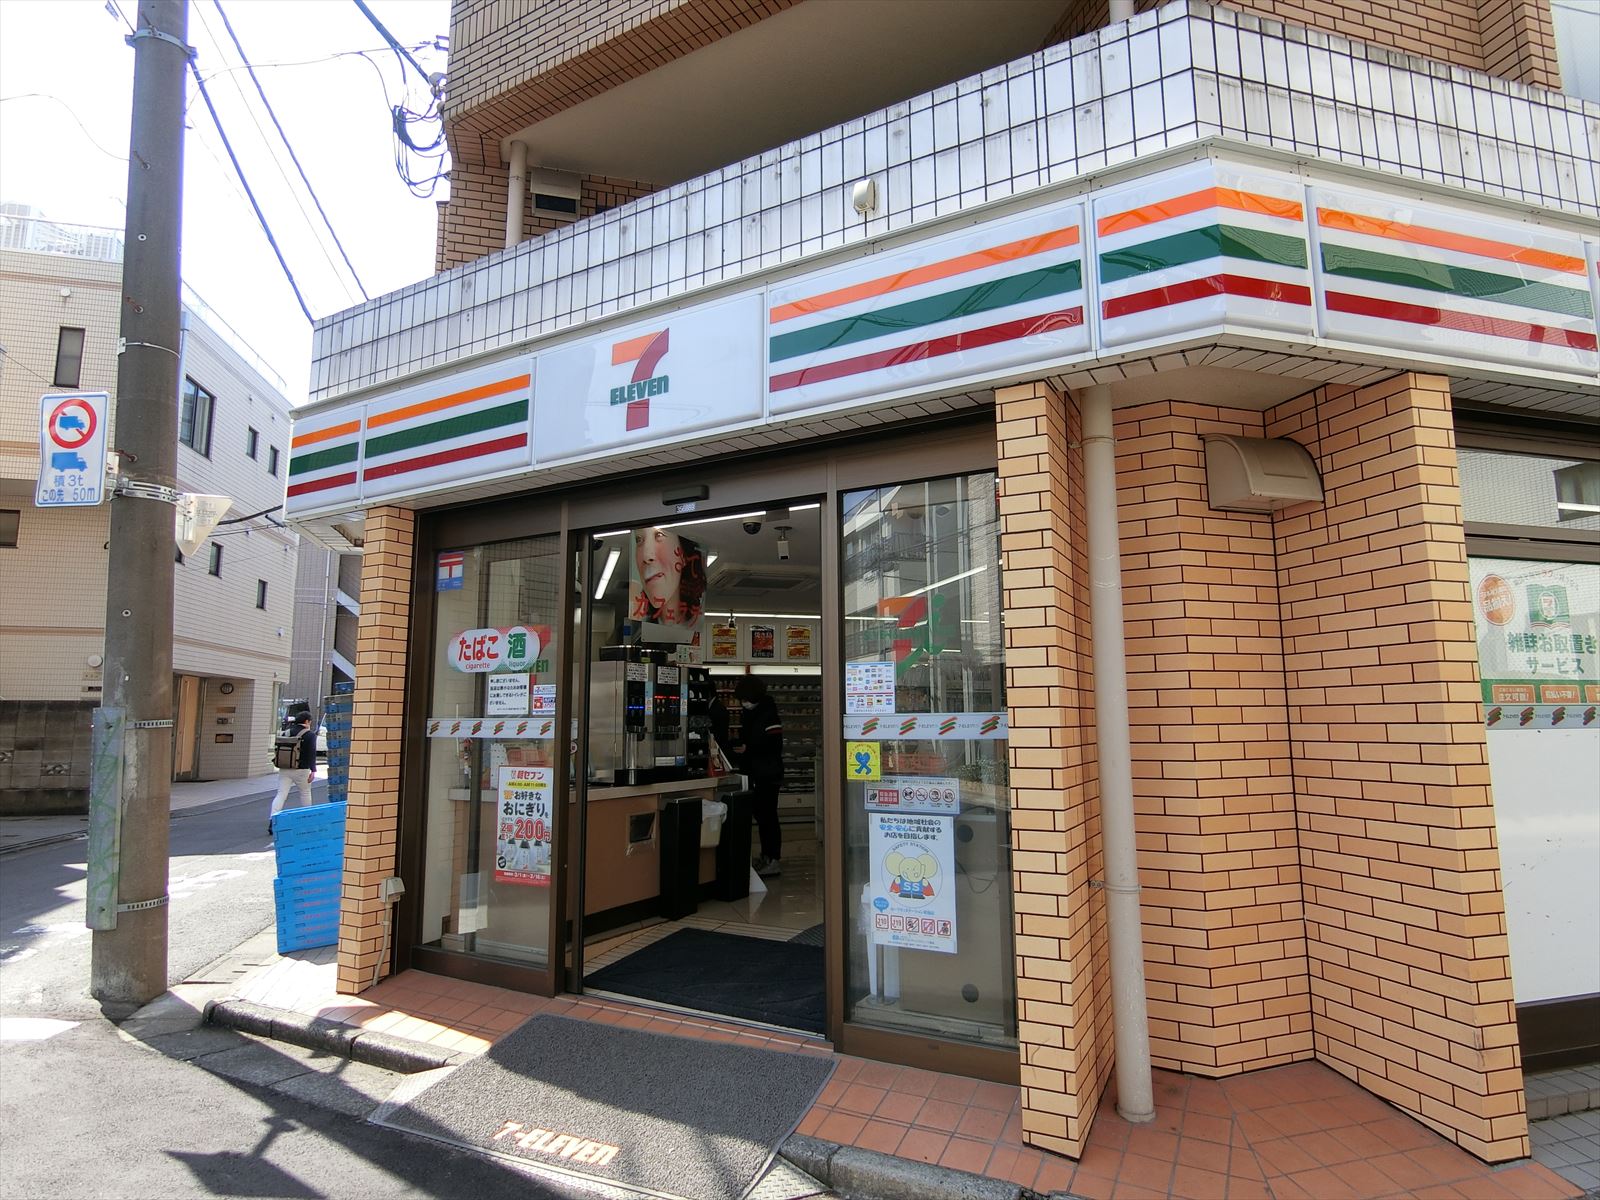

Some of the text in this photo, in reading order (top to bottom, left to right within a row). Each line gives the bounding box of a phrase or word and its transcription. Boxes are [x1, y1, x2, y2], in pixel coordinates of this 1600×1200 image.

[42, 487, 96, 502] この先 50m
[458, 632, 527, 661] たばこ 酒
[465, 662, 491, 670] cigarette
[1527, 656, 1584, 675] サービス
[514, 791, 542, 801] お好きな
[880, 817, 941, 826] 私たちは地域社会の
[514, 817, 552, 842] 200円
[903, 882, 920, 892] SS
